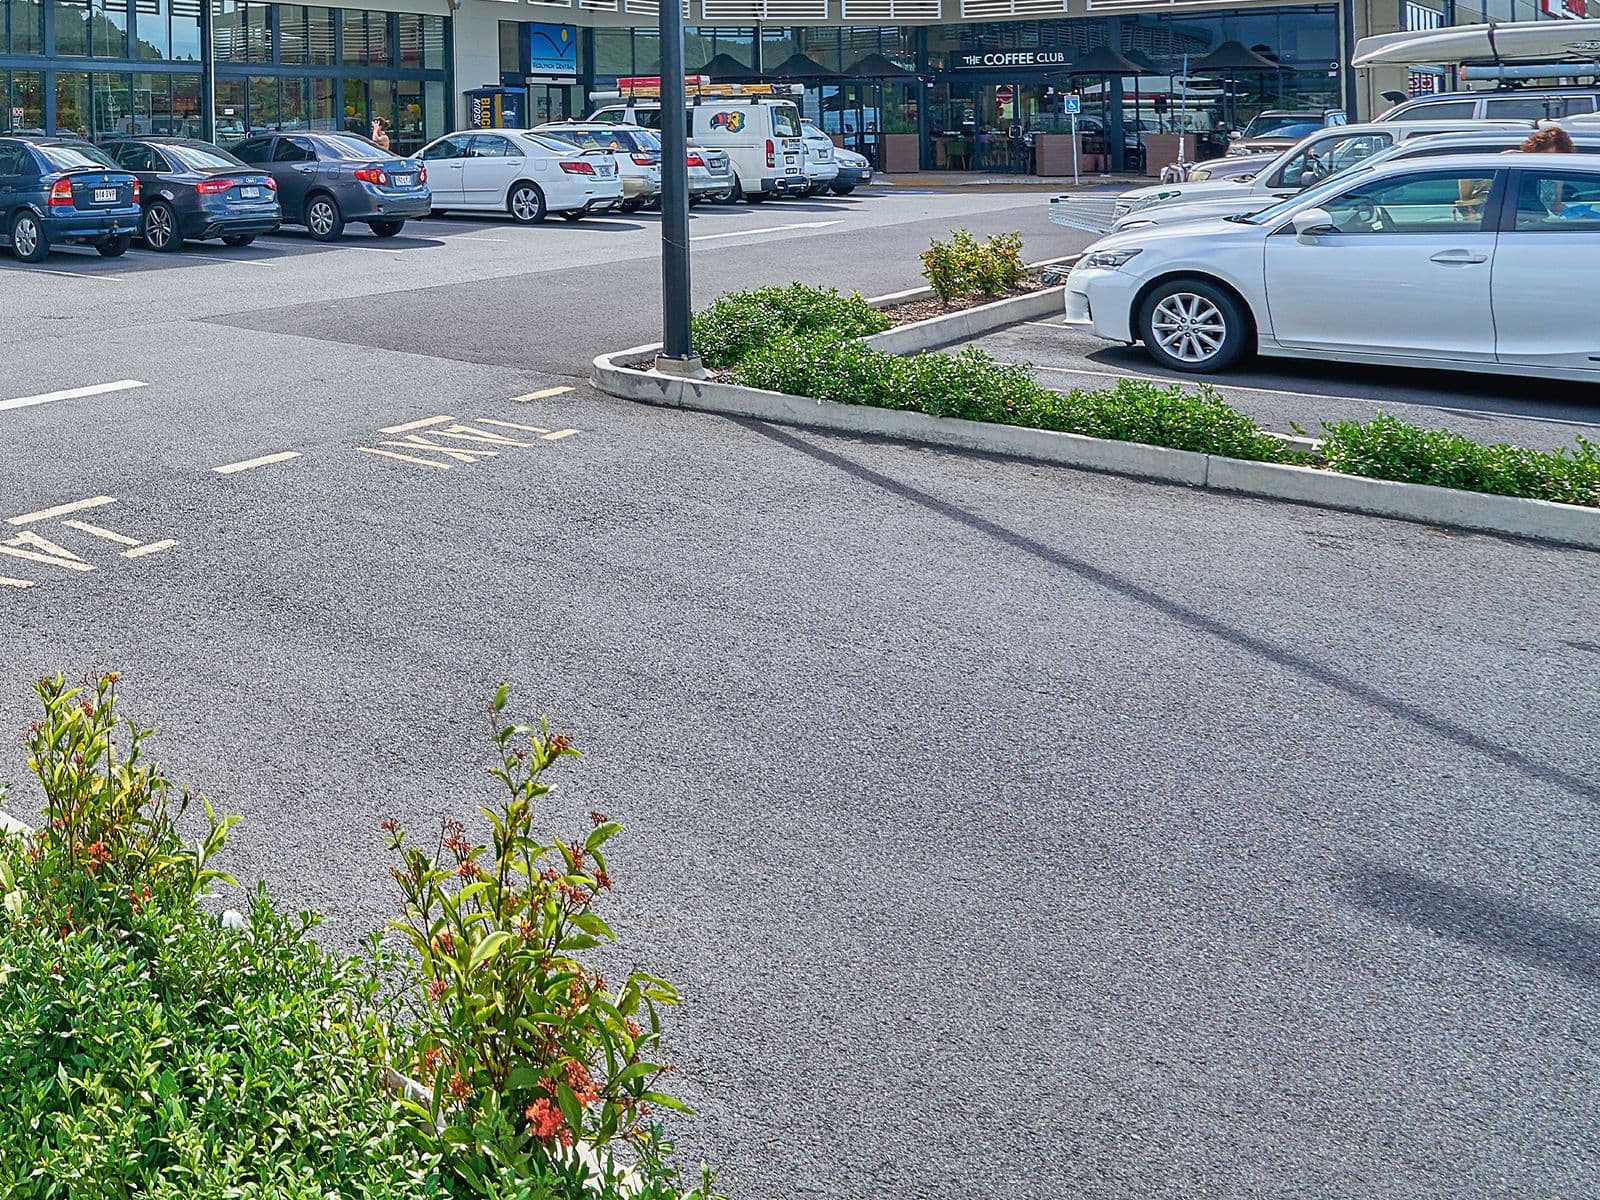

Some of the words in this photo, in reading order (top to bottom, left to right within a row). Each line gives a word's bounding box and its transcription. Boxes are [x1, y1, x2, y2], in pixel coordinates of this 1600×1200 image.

[962, 55, 981, 65] THE
[984, 52, 1034, 65] COFFEE
[1036, 52, 1065, 63] CLUB
[473, 98, 482, 127] KIOSK
[357, 418, 581, 469] TAXI
